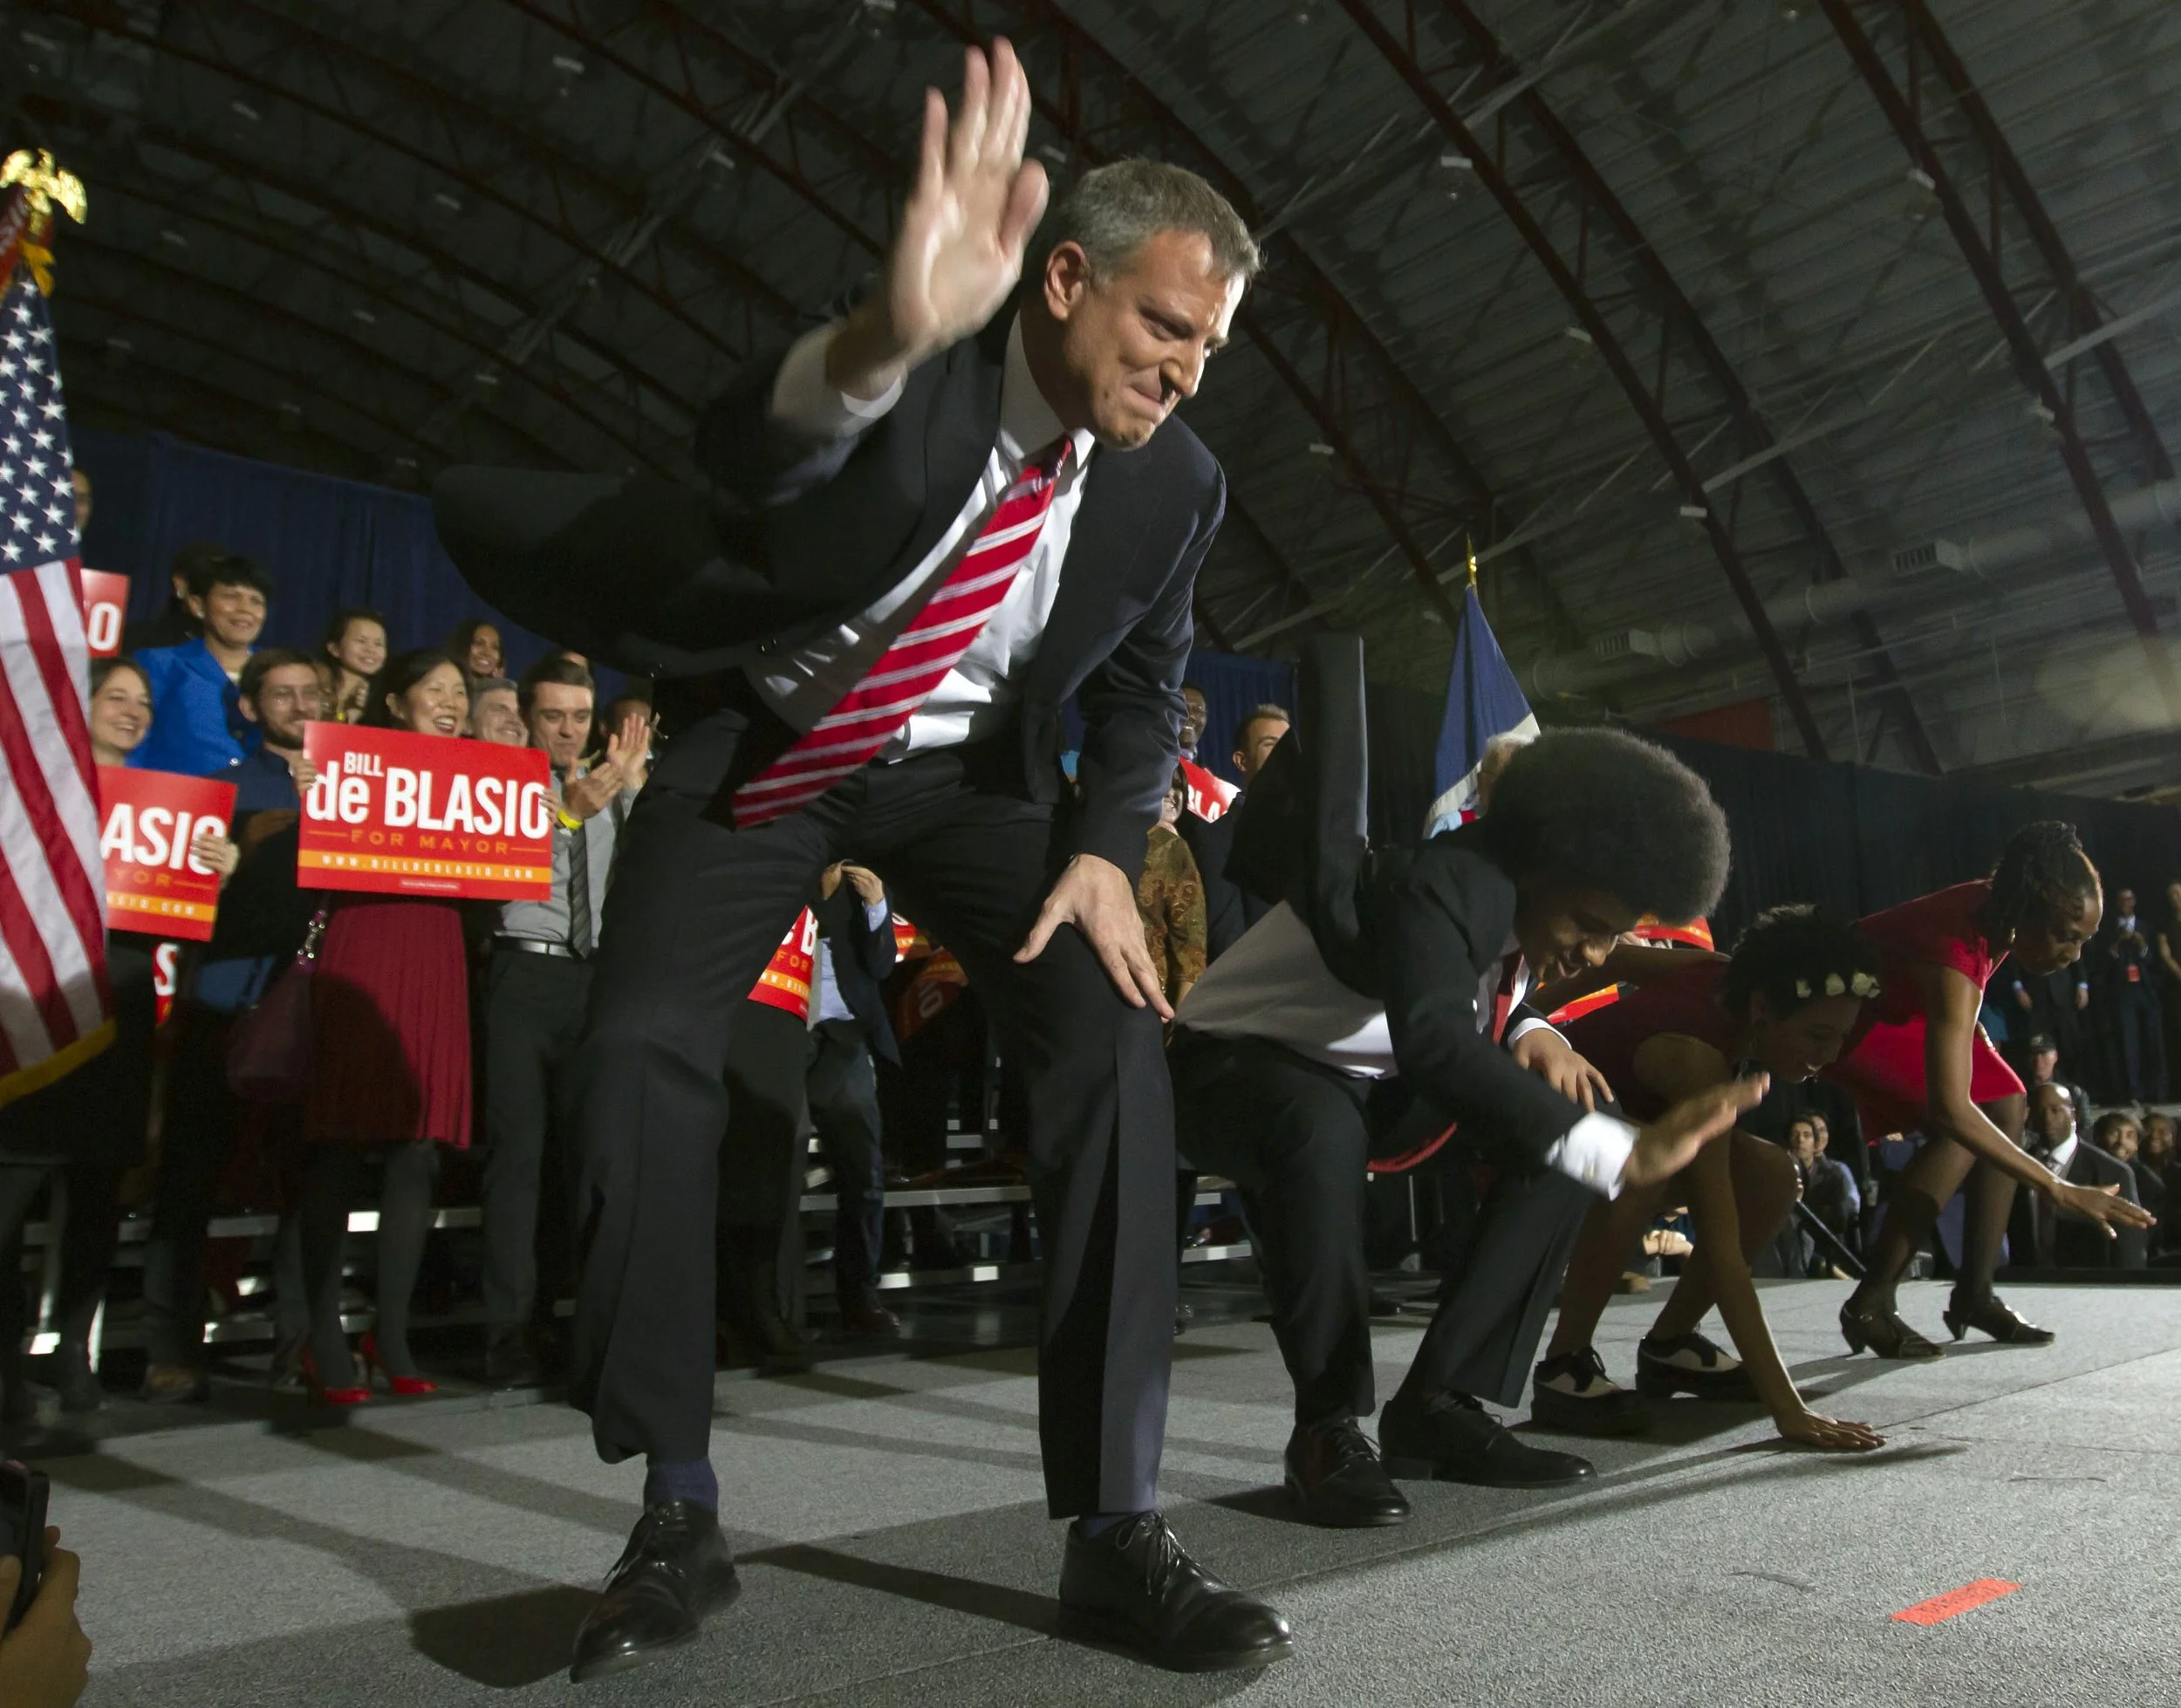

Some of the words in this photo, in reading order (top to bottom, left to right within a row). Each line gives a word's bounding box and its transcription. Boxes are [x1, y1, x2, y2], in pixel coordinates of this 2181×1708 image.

[85, 601, 122, 651] O
[344, 751, 384, 777] BILL
[306, 761, 370, 823] de
[384, 767, 549, 839] BLASIO
[1187, 783, 1227, 823] BLA
[351, 830, 405, 846] FOR
[419, 835, 508, 855] MAYOR
[776, 950, 809, 972] FOR
